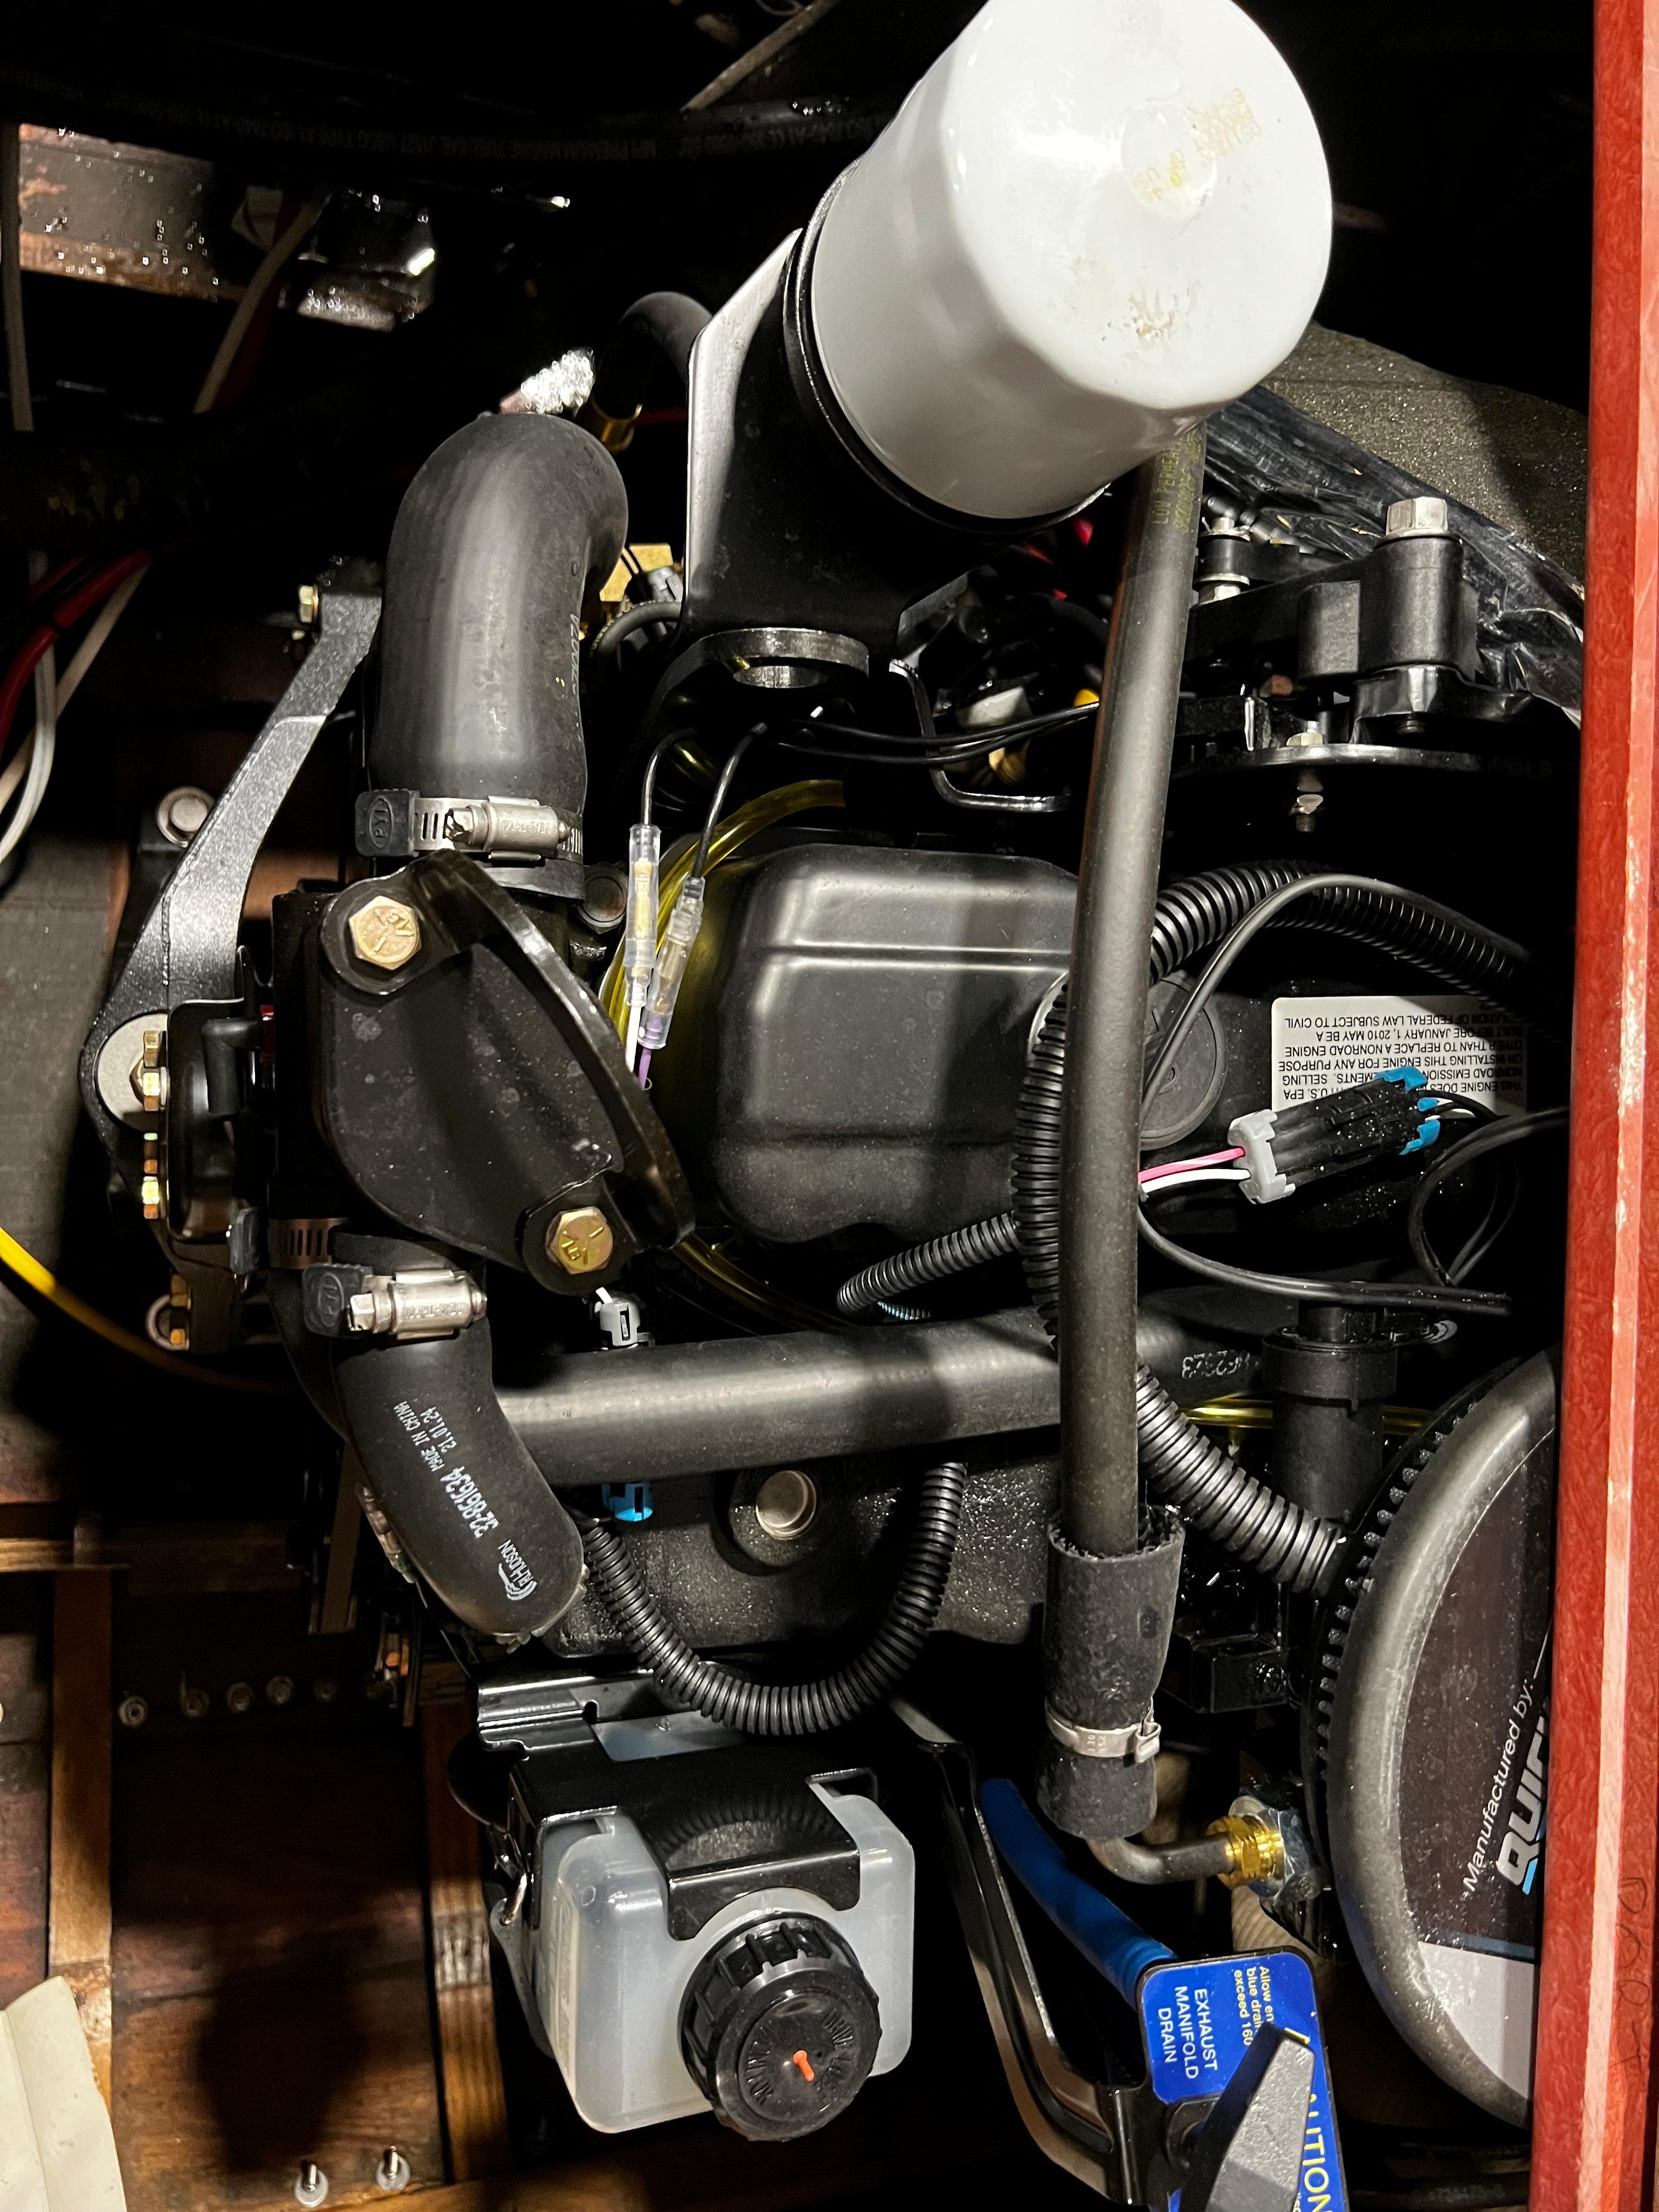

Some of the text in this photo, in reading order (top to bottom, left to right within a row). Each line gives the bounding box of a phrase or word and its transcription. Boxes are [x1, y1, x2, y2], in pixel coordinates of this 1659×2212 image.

[1285, 1018, 1311, 1028] CIVIL
[1314, 1017, 1329, 1028] TO
[1331, 1016, 1379, 1027] SUBJECT
[1382, 1015, 1404, 1026] LAW
[1407, 1014, 1452, 1025] FEDERAL
[1455, 1014, 1469, 1024] OF
[1316, 1031, 1323, 1041] A
[1325, 1031, 1340, 1041] BE
[1342, 1031, 1364, 1041] MAY
[1367, 1030, 1390, 1040] 2010
[1393, 1028, 1401, 1039] 1,
[1404, 1028, 1451, 1040] JANUARY
[1454, 1027, 1493, 1038] BEFORE
[1285, 1039, 1521, 1057] OTHER THAN TO REPLACE A NONROAD ENGINE
[1278, 1053, 1521, 1071] OR INSTALLING THIS ENGINE FOR ANY PURPOSE
[1473, 1066, 1521, 1078] NONROAD
[1282, 1074, 1327, 1086] SELLING
[1430, 1082, 1458, 1092] DOES
[1460, 1081, 1497, 1092] ENGINE
[1500, 1081, 1521, 1091] THIS
[1283, 1088, 1304, 1099] EPA
[1308, 1088, 1327, 1099] U.S.
[394, 1401, 445, 1471] MADE IN CHINA
[440, 1466, 499, 1538] 32-861634
[1463, 1679, 1534, 1892] Manufactured by:
[1246, 1966, 1258, 1996] blue
[1259, 1966, 1271, 2002] Allow
[1234, 1970, 1250, 2018] exceed
[1175, 1985, 1199, 2079] MANIFOLD
[1194, 1988, 1218, 2070] EXHAUST
[1158, 2007, 1177, 2063] DRAIN
